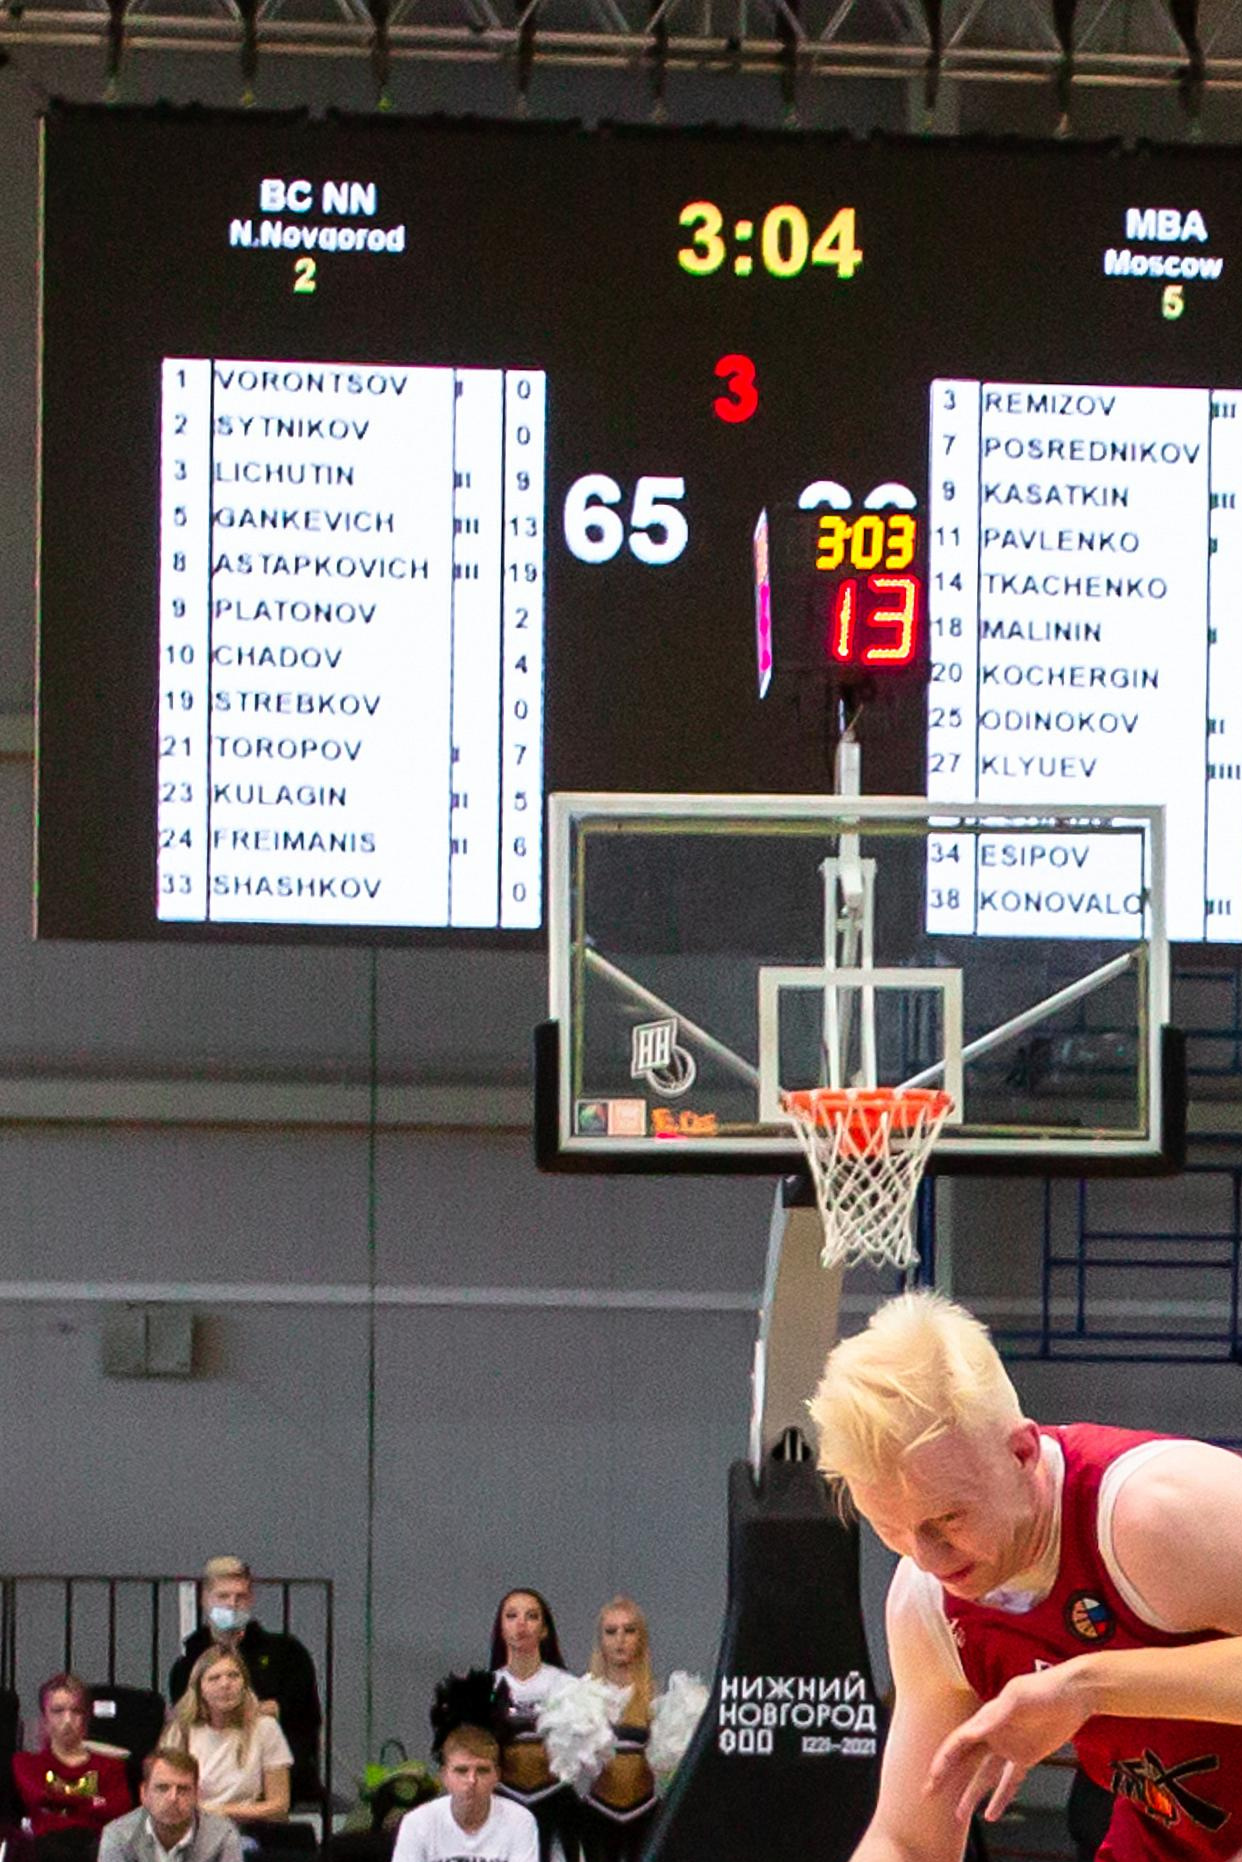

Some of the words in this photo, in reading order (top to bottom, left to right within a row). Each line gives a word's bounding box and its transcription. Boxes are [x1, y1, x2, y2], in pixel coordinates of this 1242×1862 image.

[260, 179, 312, 212] BC
[321, 180, 376, 216] NN
[678, 201, 863, 279] 3:04
[1126, 207, 1208, 243] MBA
[293, 256, 317, 294] 2
[1104, 248, 1224, 280] Moscow
[1162, 284, 1185, 321] 5
[177, 368, 186, 389] 1
[214, 368, 408, 397] VORONTSOV
[516, 379, 532, 400] 0
[714, 353, 759, 423] 3
[943, 388, 957, 411] 3
[984, 392, 1116, 417] REMIZOV
[174, 414, 188, 435] 2
[217, 415, 370, 441] SYTNIKOV
[516, 425, 531, 446] 0
[943, 434, 956, 456] 7
[983, 437, 1200, 465] POSREDNIKOV
[174, 459, 188, 481] 3
[215, 461, 354, 487] LICHUTIN
[515, 471, 531, 492] 9
[942, 480, 956, 502] 9
[983, 482, 1129, 508] KASATKIN
[509, 516, 538, 538] 13
[563, 473, 689, 566] 65
[935, 526, 960, 547] 11
[983, 527, 1140, 553] PAVLENKO
[213, 552, 429, 580] ASTAPKOVICH
[508, 562, 538, 583] 19
[935, 571, 963, 592] 14
[985, 573, 1168, 600] TKACHENKO
[171, 598, 186, 619] 9
[214, 598, 377, 625] PLATONOV
[515, 607, 529, 629] 2
[834, 573, 921, 666] 13
[933, 617, 963, 638] 18
[982, 619, 1102, 643] MALININ
[166, 644, 195, 665] 10
[213, 645, 343, 669] CHADOV
[514, 654, 529, 675] 4
[931, 661, 963, 683] 20
[982, 664, 1159, 690] KOCHERGIN
[165, 690, 194, 711] 19
[215, 691, 381, 717] STREBKOV
[513, 699, 529, 720] 0
[930, 707, 963, 729] 25
[981, 709, 1139, 734] ODINOKOV
[160, 735, 191, 757] 21
[215, 735, 362, 762] TOROPOV
[514, 743, 527, 766] 7
[930, 752, 961, 773] 27
[981, 756, 1097, 778] KLYUEV
[161, 782, 193, 803] 23
[213, 783, 347, 807] KULAGIN
[514, 791, 528, 812] 5
[160, 828, 193, 849] 24
[213, 829, 376, 854] FREIMANIS
[513, 836, 527, 857] 6
[931, 842, 961, 864] 34
[980, 844, 1090, 869] ESIPOV
[162, 874, 192, 895] 33
[213, 875, 382, 899] SHASHKOV
[512, 883, 527, 903] 0
[930, 888, 960, 910] 38
[980, 891, 1145, 915] KONOVALO
[720, 1671, 866, 1701] НИЖНИЙ
[719, 1702, 877, 1732] НОВГОРОД
